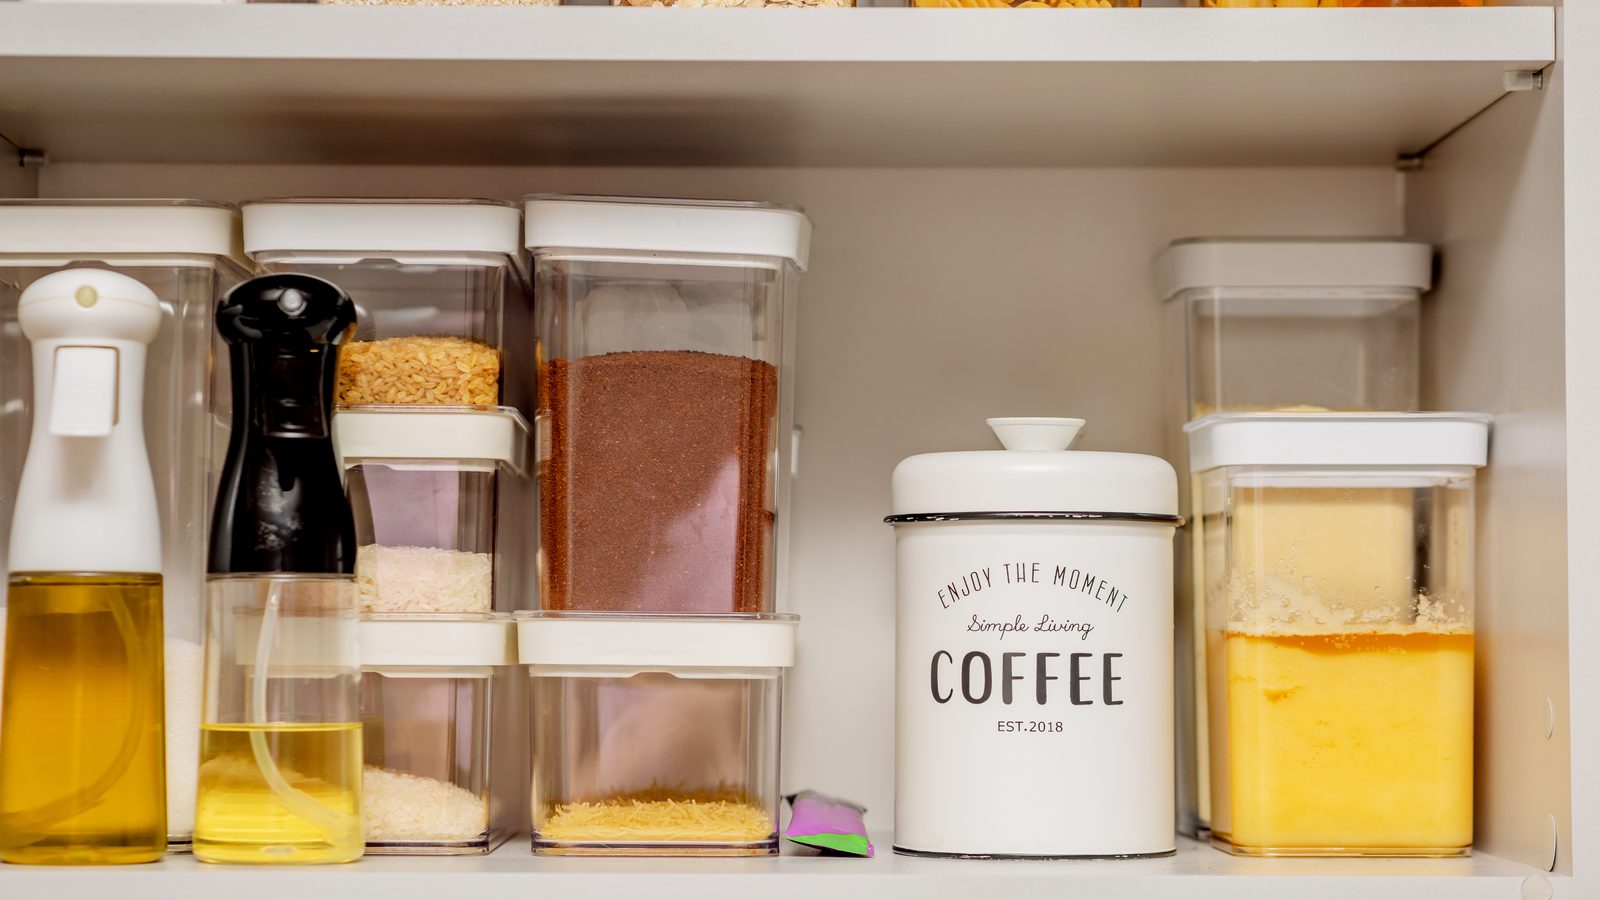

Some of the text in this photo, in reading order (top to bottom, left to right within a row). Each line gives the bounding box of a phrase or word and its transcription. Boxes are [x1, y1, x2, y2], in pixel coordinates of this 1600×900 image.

[937, 562, 1128, 613] ENJOY THE MOMENT
[966, 614, 1095, 641] Simple Living
[930, 649, 1124, 706] COFFEE
[997, 720, 1064, 733] EST.2018
